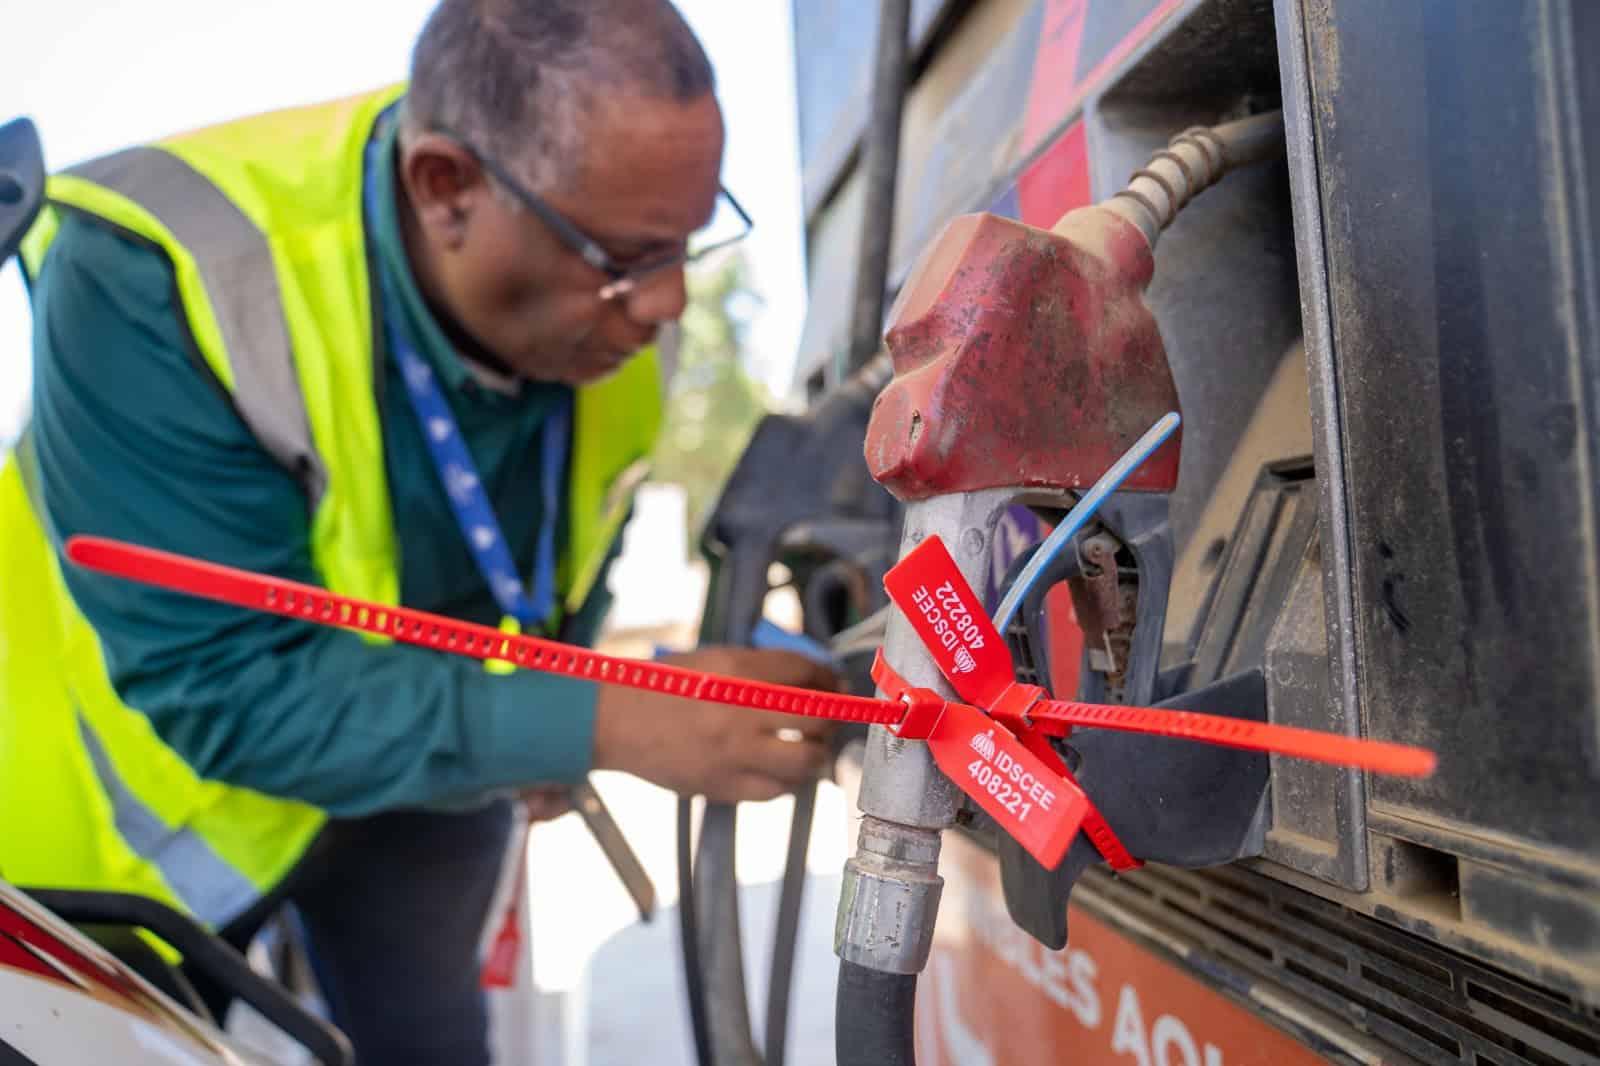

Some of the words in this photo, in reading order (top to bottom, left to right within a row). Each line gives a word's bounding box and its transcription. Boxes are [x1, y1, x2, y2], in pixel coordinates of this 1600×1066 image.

[912, 586, 958, 651] IDSCEE
[936, 581, 984, 650] 408222
[967, 760, 1031, 822] 408221
[994, 750, 1055, 811] IDSCEE
